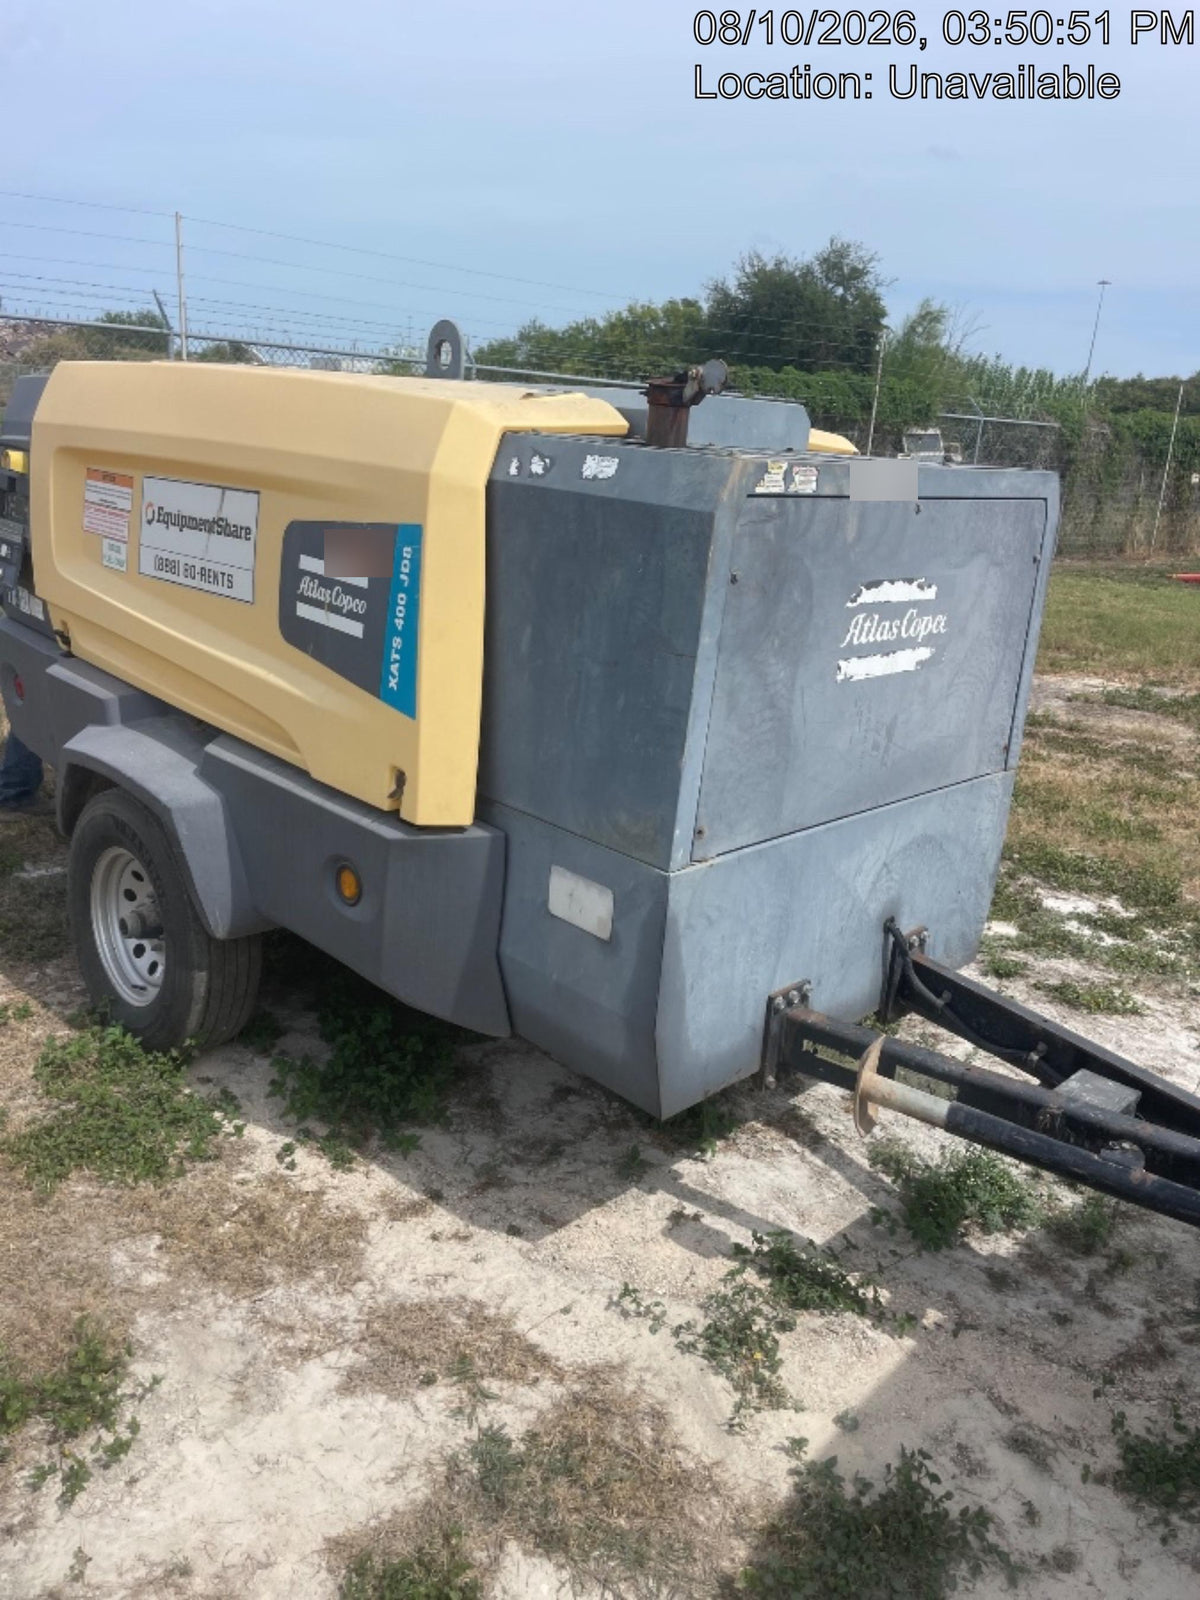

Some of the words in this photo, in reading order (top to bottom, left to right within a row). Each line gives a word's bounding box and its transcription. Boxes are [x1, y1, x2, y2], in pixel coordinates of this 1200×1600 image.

[157, 506, 252, 541] EquipmentShare
[297, 576, 331, 602] Atlas
[331, 586, 367, 614] Copco
[394, 593, 407, 632] 400
[840, 613, 900, 648] Atlas
[389, 636, 403, 691] XATS
